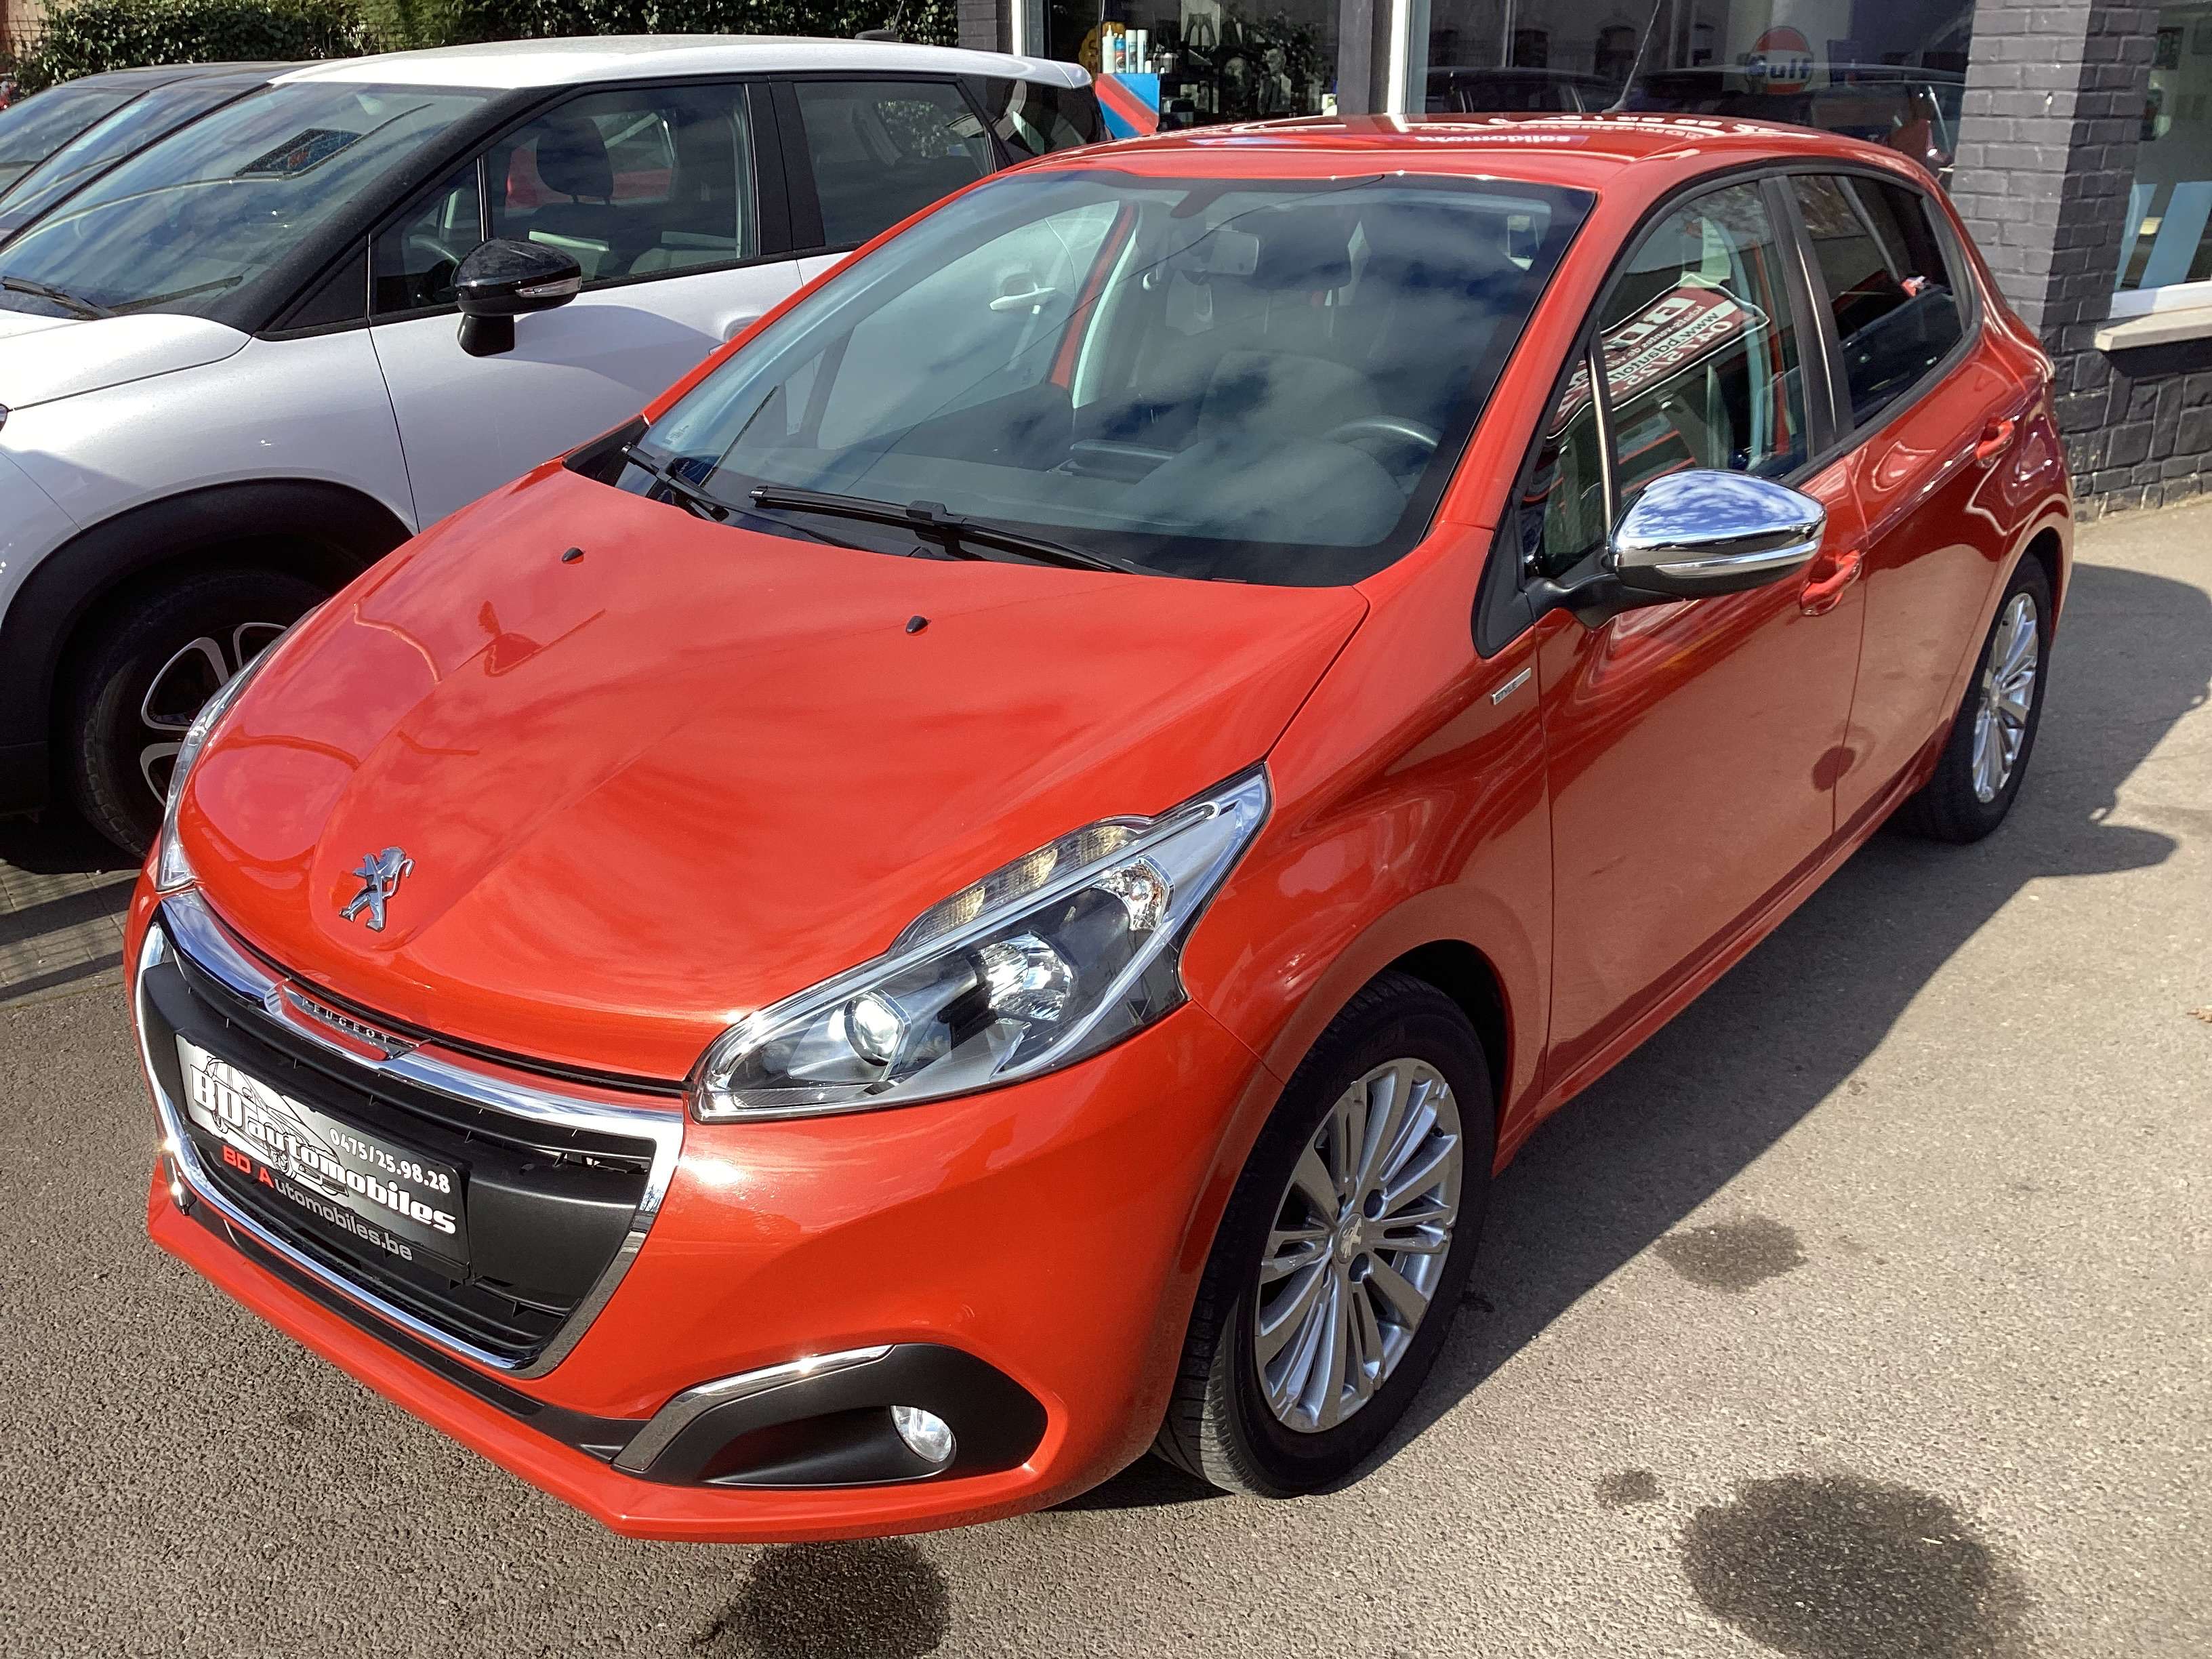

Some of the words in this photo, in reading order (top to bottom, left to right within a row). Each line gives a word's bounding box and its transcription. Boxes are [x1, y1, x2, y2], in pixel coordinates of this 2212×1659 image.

[302, 997, 390, 1044] PEUGEOT
[190, 1064, 243, 1128] BD
[247, 1115, 457, 1235] automobiles
[222, 1145, 251, 1174] BD
[329, 1127, 451, 1193] 0475/25.98.28
